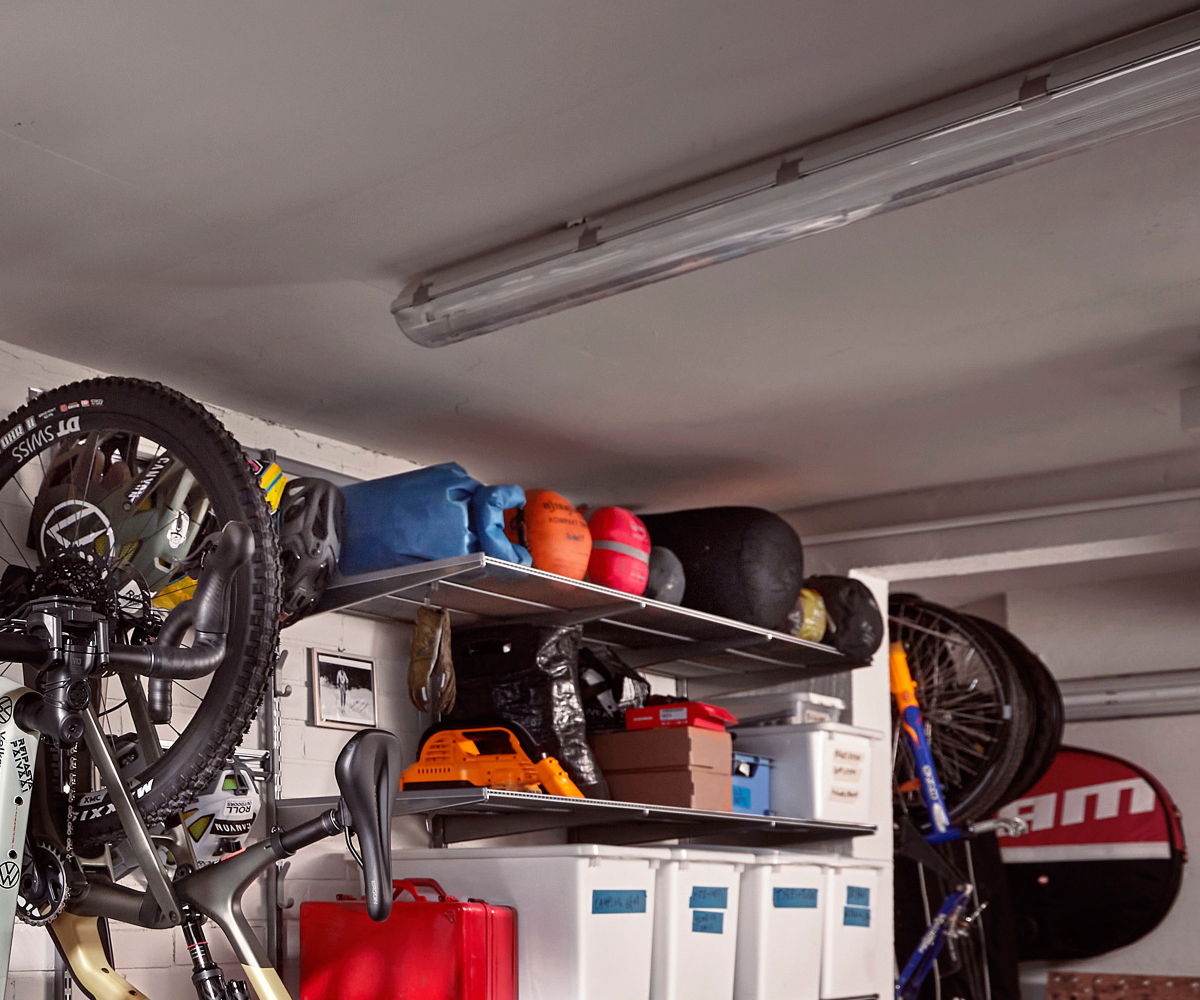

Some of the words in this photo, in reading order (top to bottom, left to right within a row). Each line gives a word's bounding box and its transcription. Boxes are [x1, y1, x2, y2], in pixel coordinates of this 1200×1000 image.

[0, 424, 25, 450] DHR
[56, 416, 81, 438] DT
[11, 425, 55, 463] SWISS
[17, 737, 34, 792] REIPASTA
[83, 793, 101, 804] XMC
[227, 806, 251, 814] ROLL
